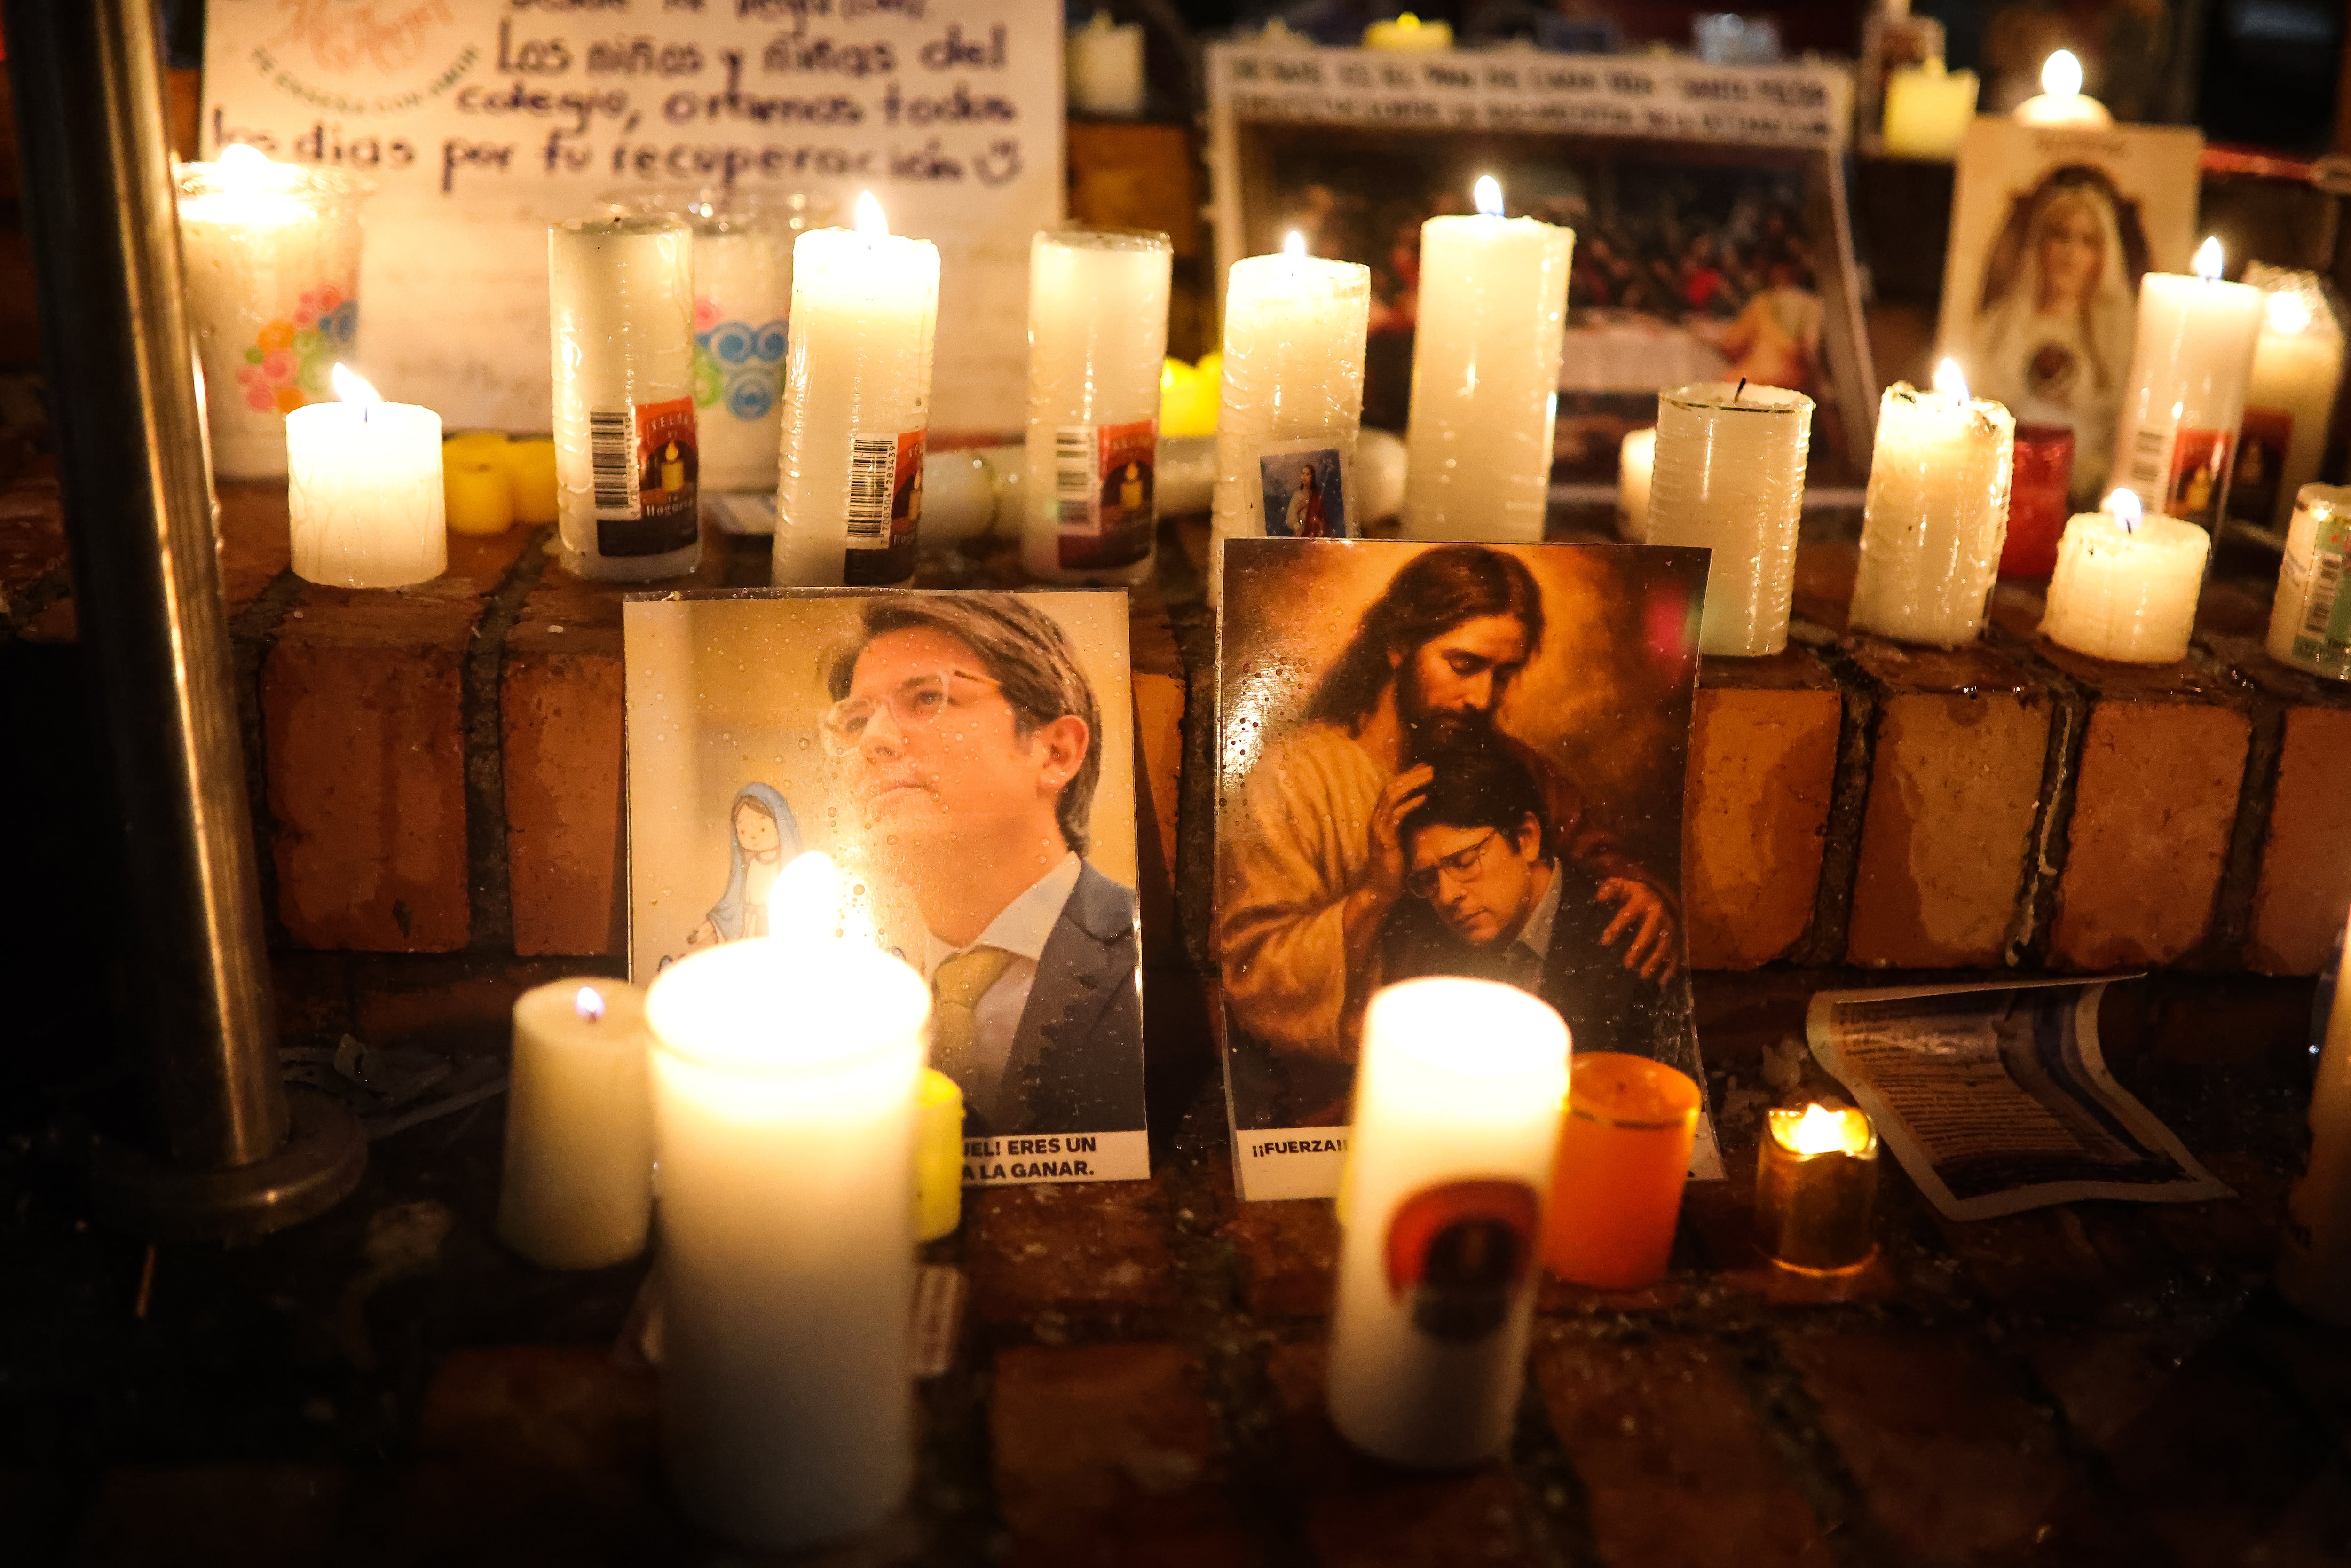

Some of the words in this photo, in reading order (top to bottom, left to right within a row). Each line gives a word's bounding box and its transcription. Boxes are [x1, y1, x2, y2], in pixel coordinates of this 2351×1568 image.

[921, 23, 1007, 71] del
[1007, 1138, 1061, 1155] ERES
[1066, 1136, 1096, 1152] UN
[979, 1164, 1006, 1179] LA
[1011, 1160, 1095, 1178] GANAR.
